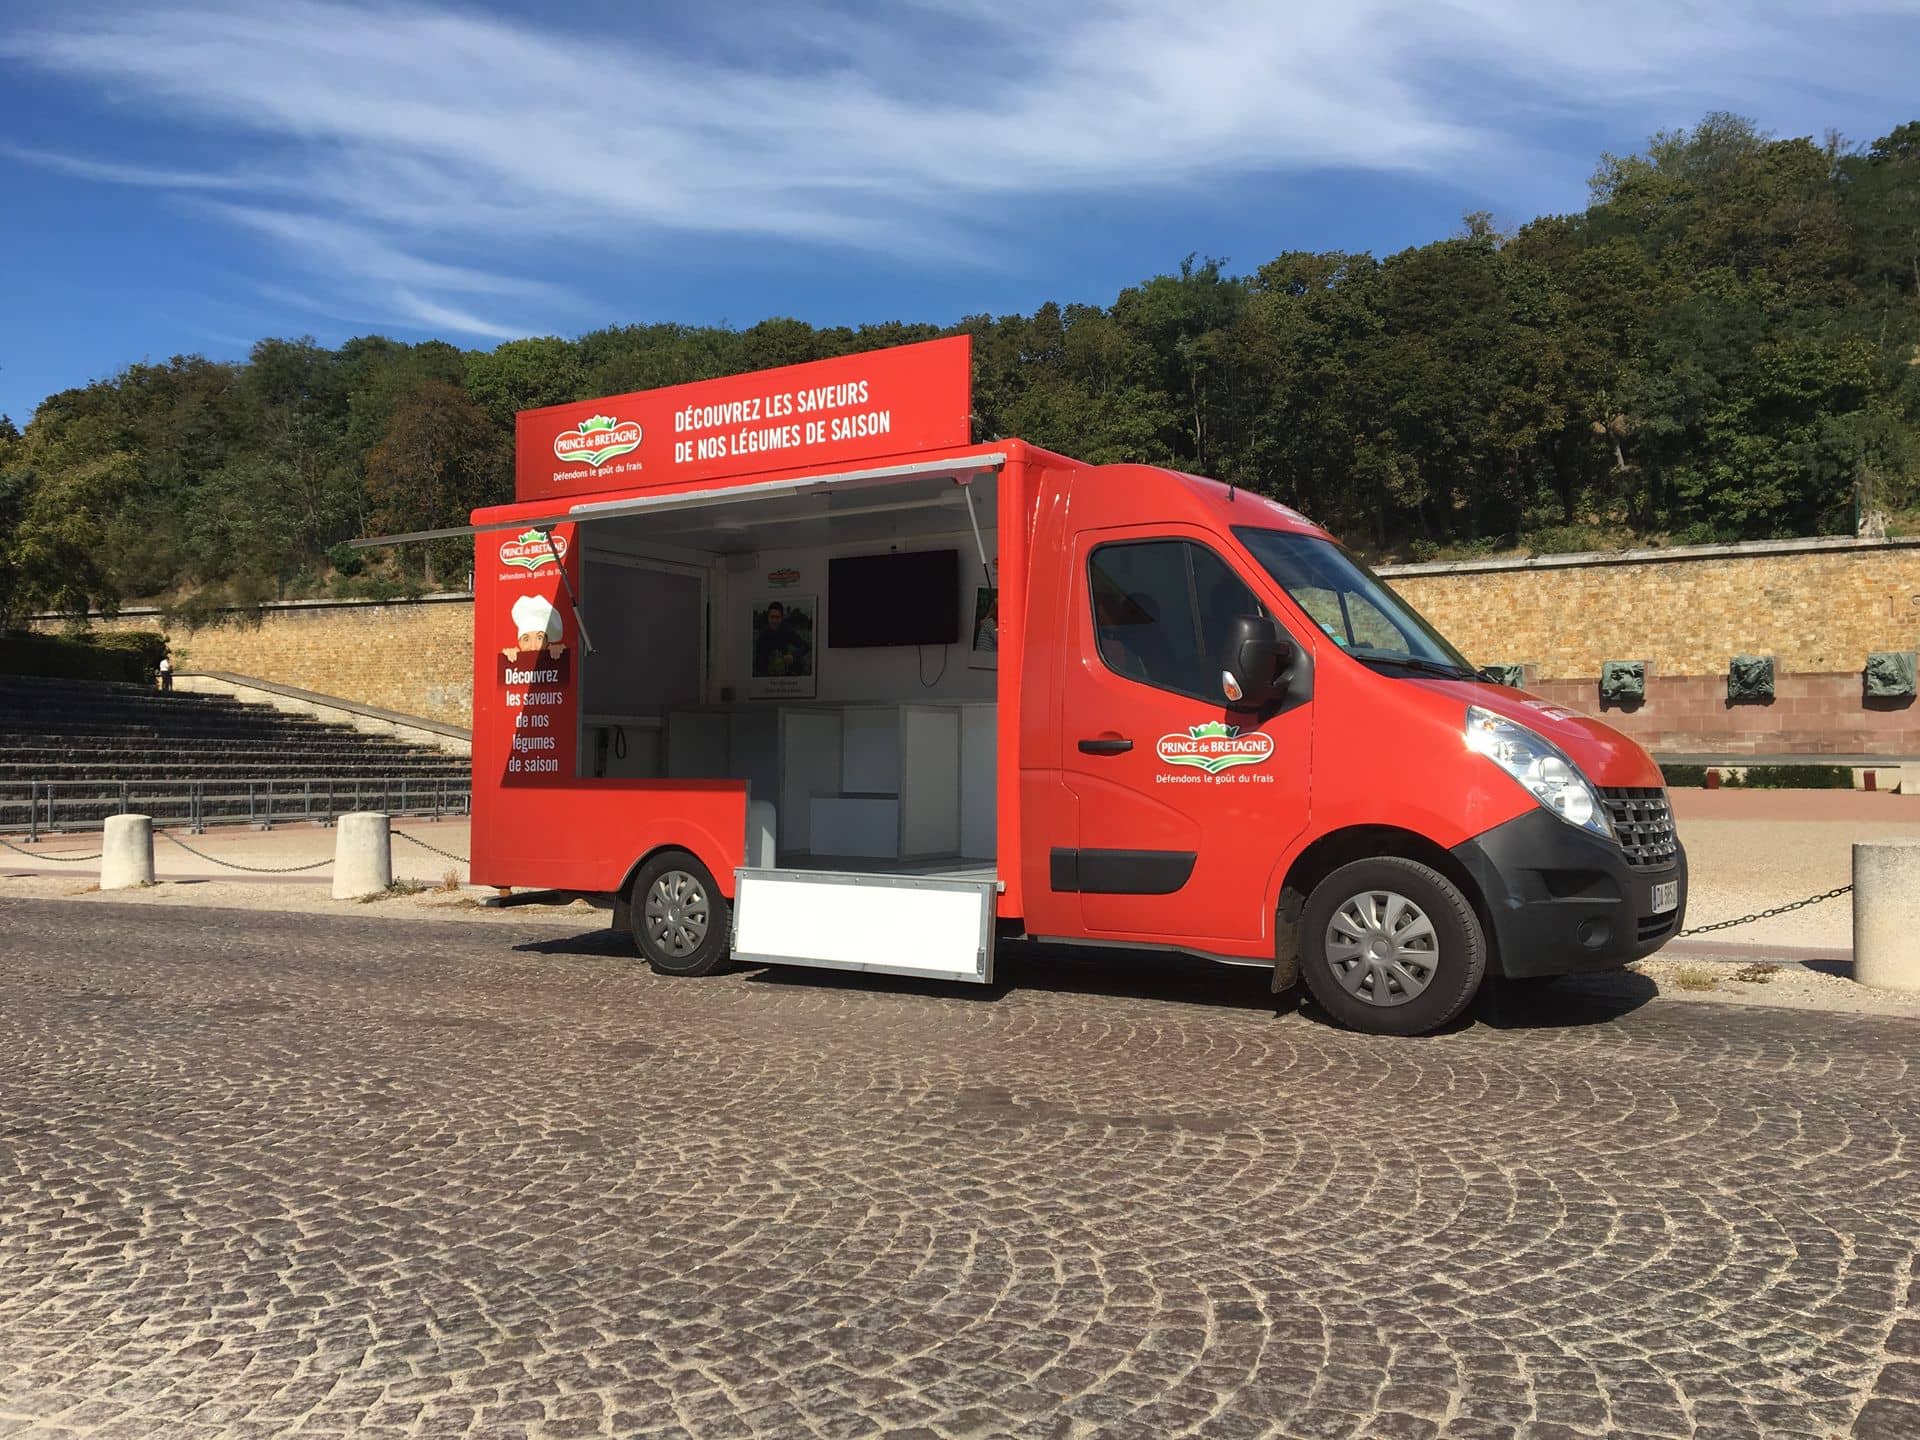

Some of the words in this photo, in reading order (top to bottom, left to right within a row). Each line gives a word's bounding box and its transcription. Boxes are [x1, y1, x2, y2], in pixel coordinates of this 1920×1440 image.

[675, 398, 761, 432] DÉCOUVREZ
[765, 393, 793, 418] LES
[797, 380, 869, 413] SAVEURS
[557, 437, 586, 451] PRINCE
[586, 438, 594, 447] de
[594, 429, 638, 446] BRETAGNE
[675, 441, 693, 464] DE
[697, 436, 727, 460] NOS
[731, 424, 801, 456] LÉGUMES
[806, 421, 826, 445] DE
[831, 410, 890, 440] SAISON
[553, 470, 588, 482] Défendons
[589, 467, 597, 476] le
[598, 465, 614, 477] goût
[615, 464, 624, 472] du
[626, 462, 643, 472] frais
[502, 546, 524, 557] PRINCE
[530, 542, 564, 554] BRETANE
[505, 667, 558, 685] Découvrez
[506, 690, 521, 707] les
[523, 692, 563, 706] saveurs
[516, 711, 529, 728] de
[531, 714, 550, 728] nos
[512, 733, 555, 753] légumes
[1161, 741, 1198, 753] PRINCE
[1199, 742, 1210, 753] de
[1210, 740, 1268, 752] BRETAGNE
[508, 756, 521, 772] de
[524, 755, 558, 772] saison
[1156, 774, 1201, 783] Défendons
[1203, 774, 1213, 783] le
[1215, 774, 1236, 785] goût
[1238, 774, 1250, 783] du
[1253, 774, 1274, 783] frais
